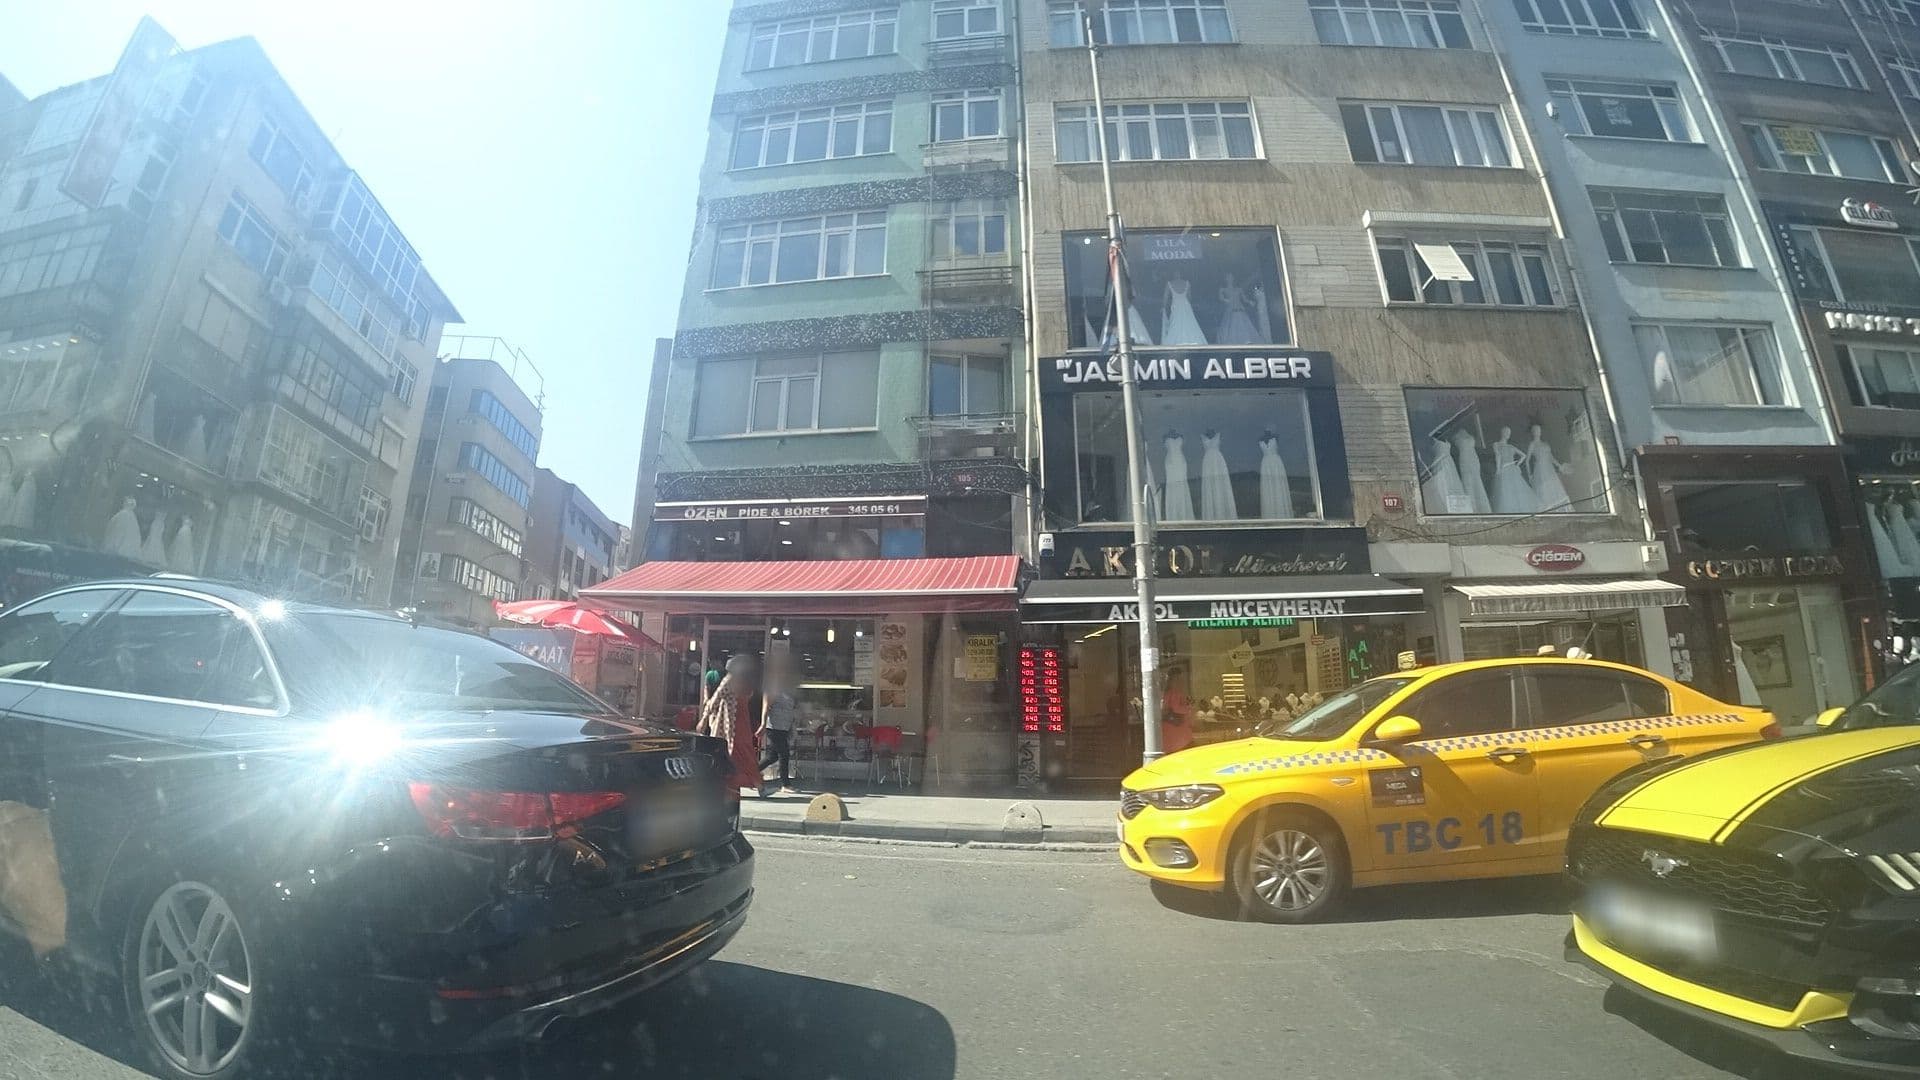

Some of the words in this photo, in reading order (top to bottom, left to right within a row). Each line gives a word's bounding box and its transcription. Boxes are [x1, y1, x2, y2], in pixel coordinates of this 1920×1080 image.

[1151, 250, 1195, 260] MODA
[1056, 358, 1072, 370] BY
[1203, 357, 1312, 380] ALBER
[1384, 498, 1397, 506] 107
[684, 506, 728, 519] ÖZEN
[770, 508, 780, 517] &
[783, 505, 830, 517] BÖREK
[848, 505, 868, 515] 345
[870, 504, 885, 514] 05
[887, 504, 900, 514] 61
[1532, 550, 1582, 566] ÇİĞDEM
[1108, 603, 1179, 620] AKOL
[1210, 599, 1345, 618] MÜCEVHERAT
[967, 638, 995, 647] KIRALIK
[1376, 817, 1462, 855] TBC
[1478, 811, 1523, 845] 18
